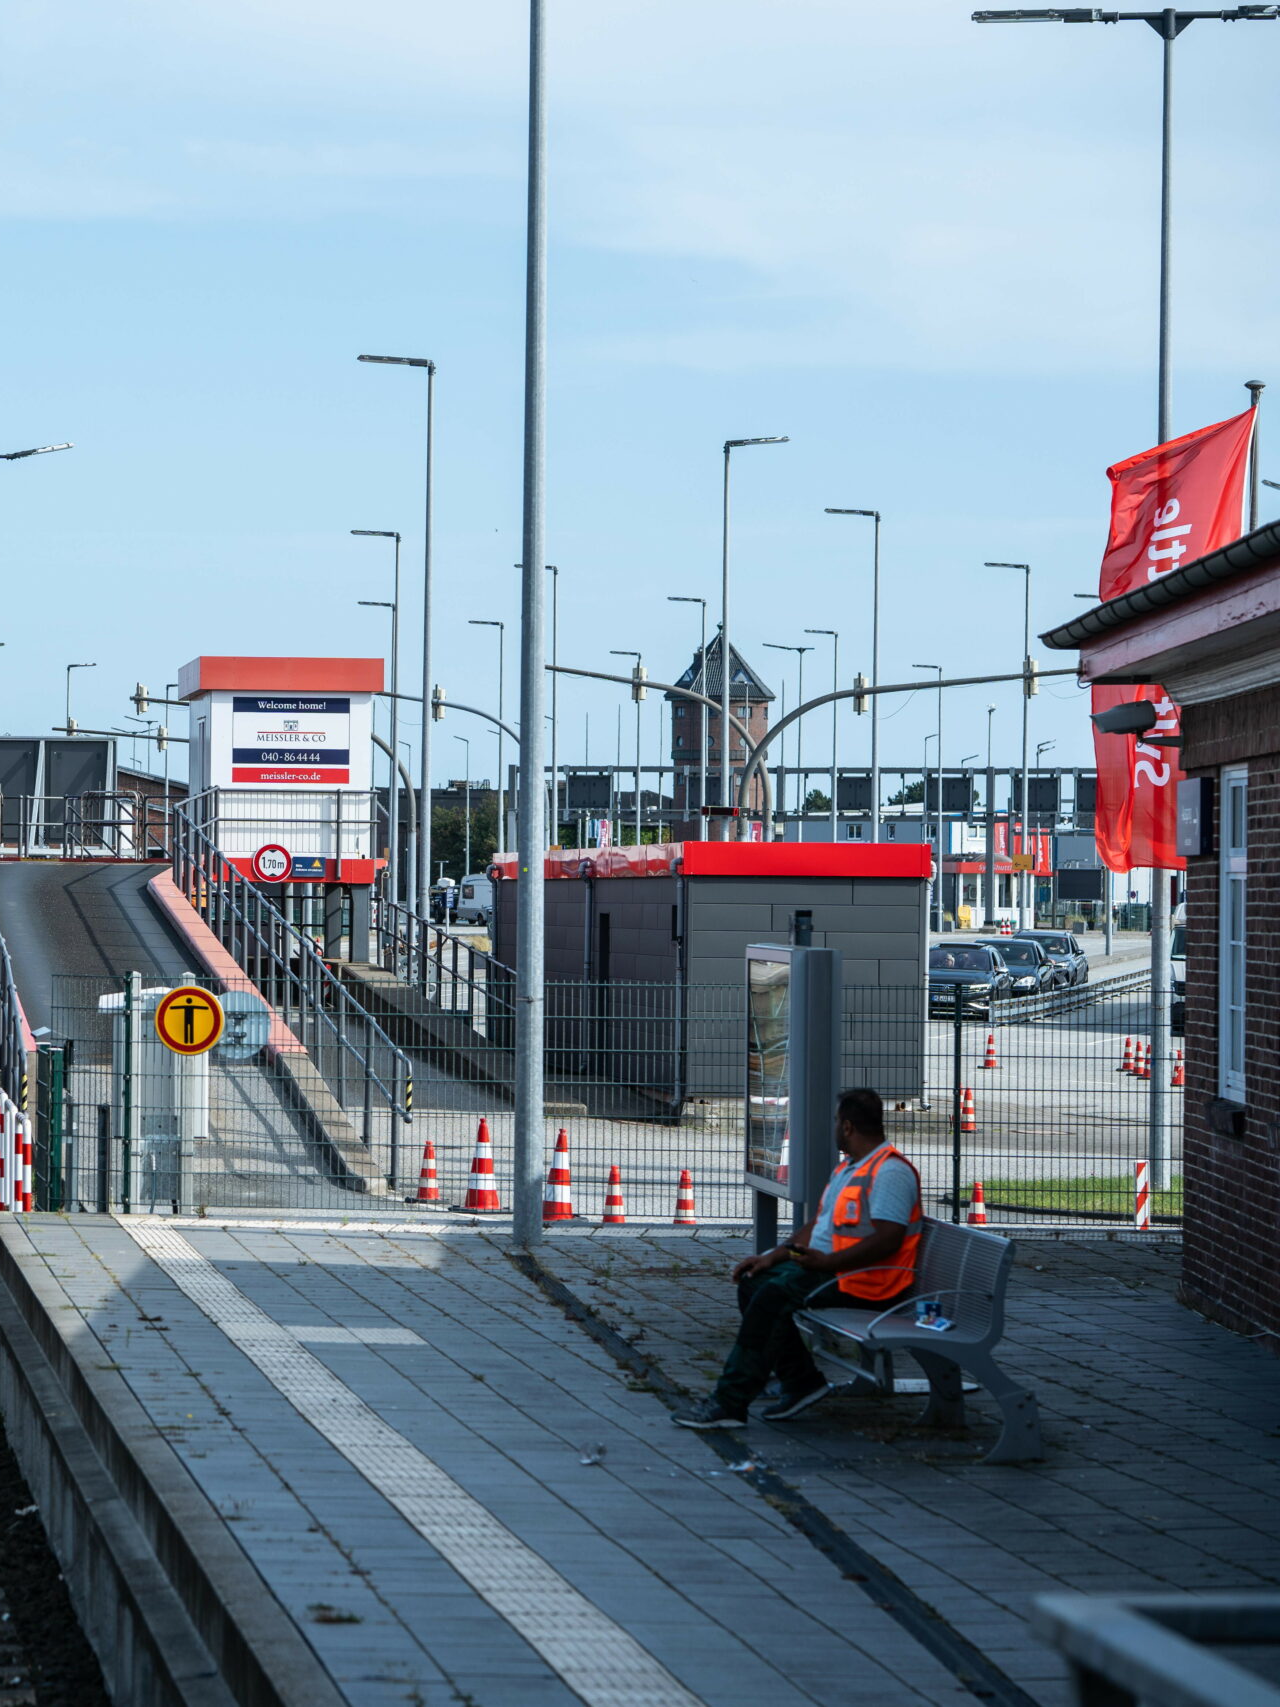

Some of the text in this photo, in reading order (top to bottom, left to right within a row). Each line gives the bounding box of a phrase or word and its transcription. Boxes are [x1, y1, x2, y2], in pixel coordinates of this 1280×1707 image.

[257, 701, 327, 710] Welcome home!
[256, 733, 326, 743] MEISSLER & CO
[261, 752, 278, 761] 040
[260, 771, 321, 781] meissler-co.de
[277, 861, 285, 869] m
